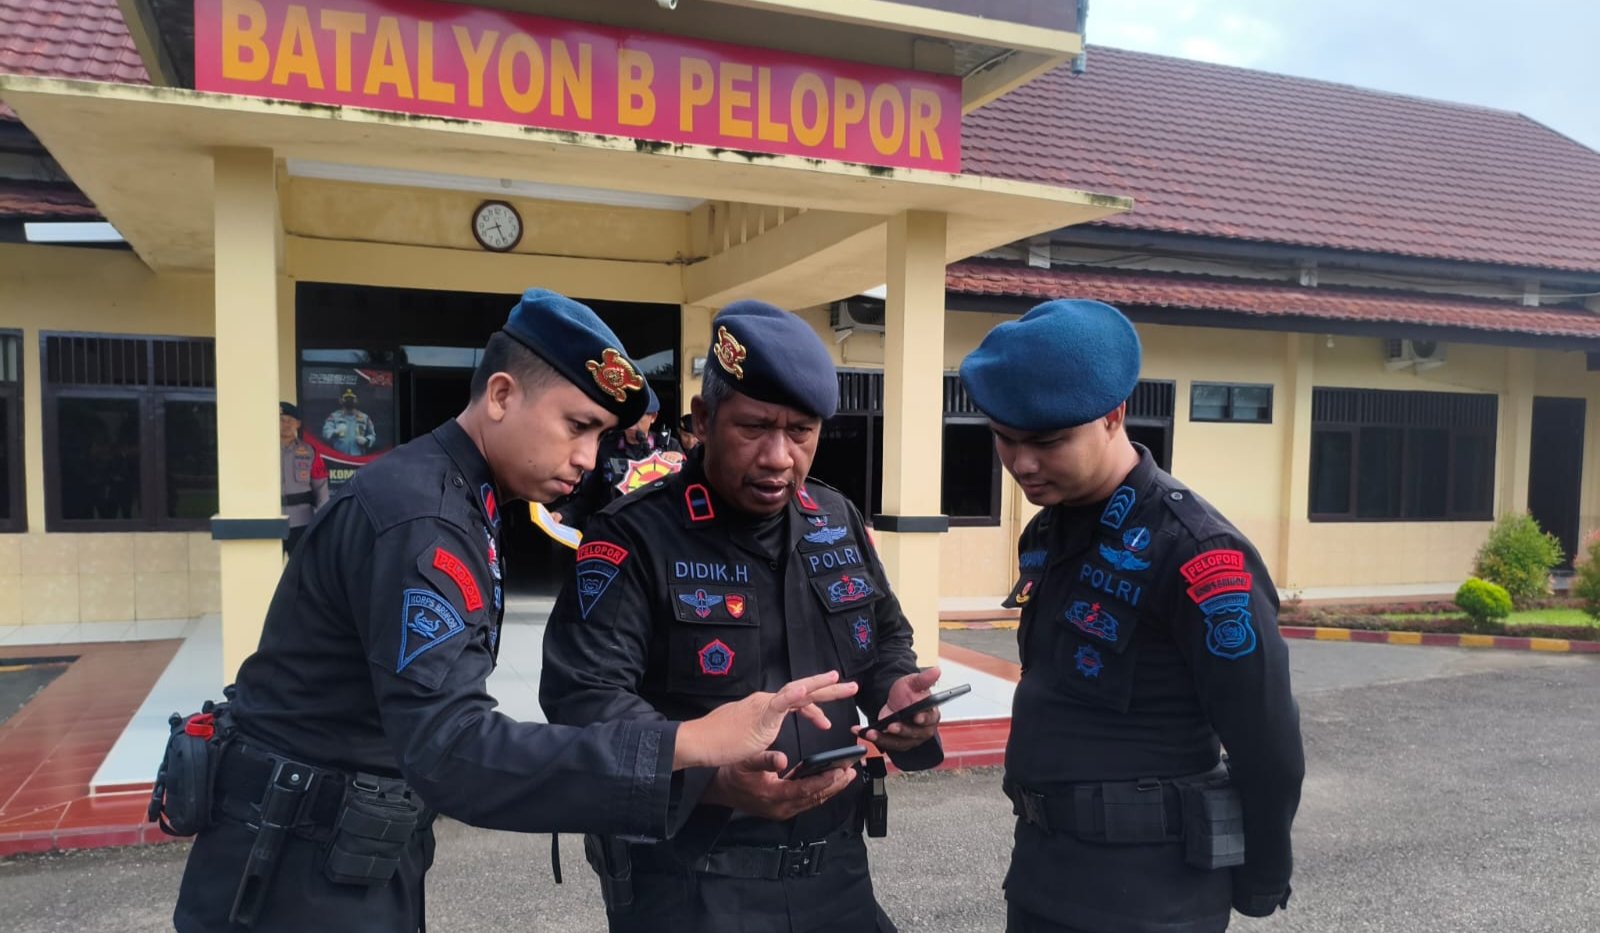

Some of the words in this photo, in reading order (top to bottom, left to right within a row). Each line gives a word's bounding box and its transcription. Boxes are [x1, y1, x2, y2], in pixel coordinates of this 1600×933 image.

[222, 0, 592, 121] BATALYON
[617, 49, 657, 128] B
[680, 57, 944, 161] PELOPOR
[329, 469, 356, 480] KOM
[579, 545, 621, 560] PELOPOR
[809, 547, 862, 572] POLRI
[675, 561, 748, 583] DIDIK.H
[1187, 554, 1239, 577] PELOPOR
[438, 554, 479, 606] PELOPOR
[1079, 563, 1142, 606] POLRI
[410, 595, 435, 608] KORPS
